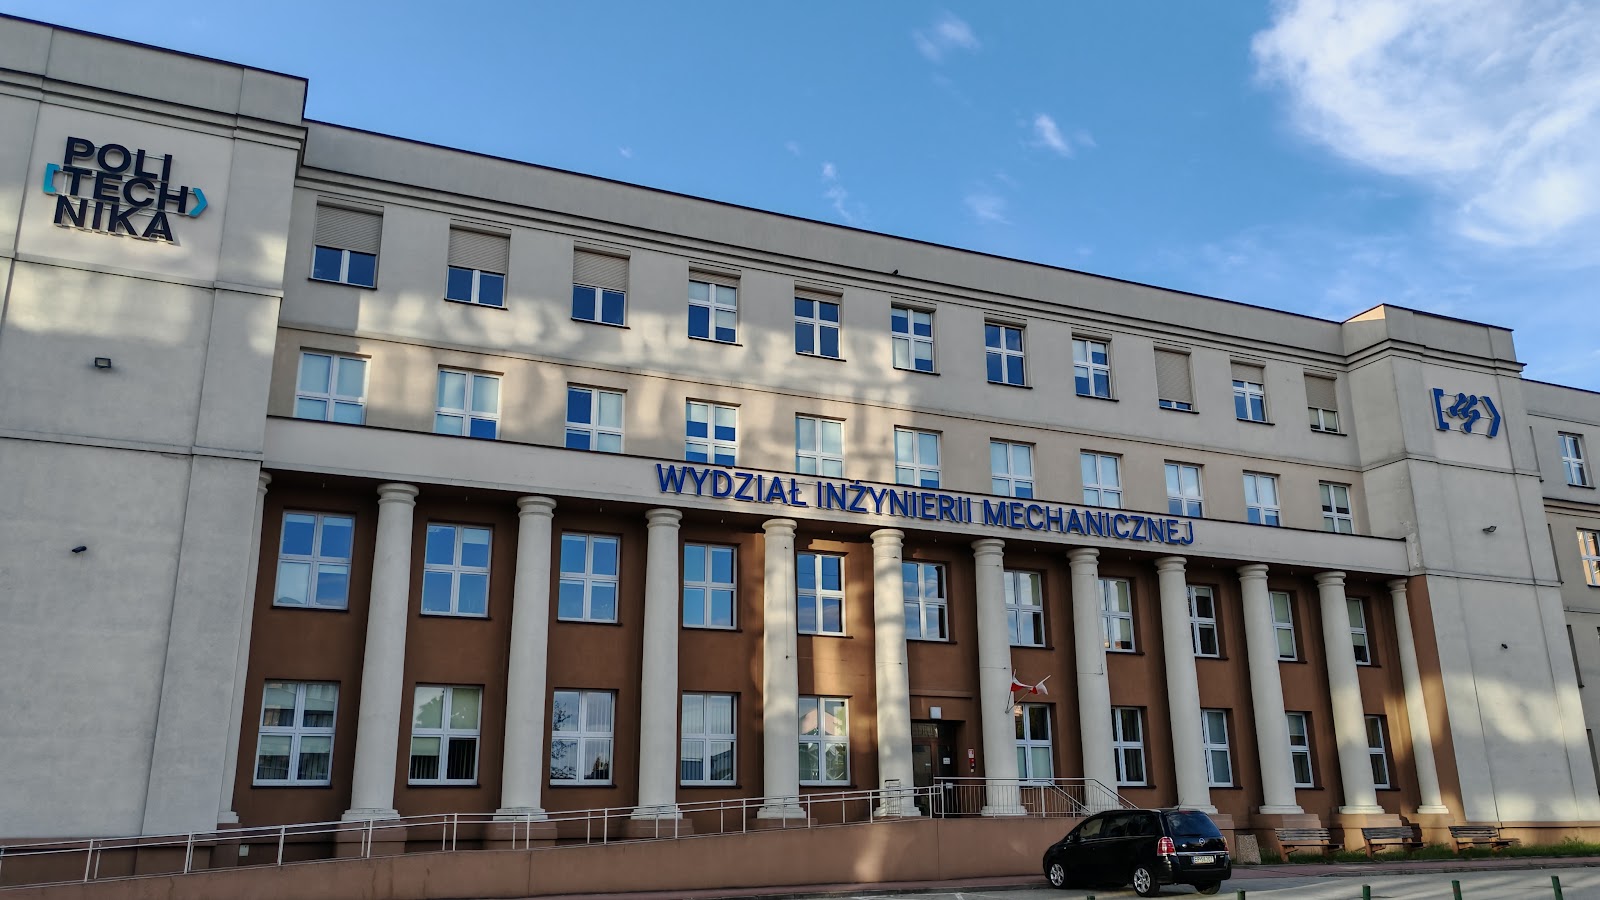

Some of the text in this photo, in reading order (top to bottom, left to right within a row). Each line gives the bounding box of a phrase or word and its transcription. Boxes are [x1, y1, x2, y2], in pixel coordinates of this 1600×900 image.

[64, 136, 173, 184] POLI
[62, 166, 189, 214] TECH
[54, 195, 174, 241] NIKA
[656, 463, 1194, 545] WYDZIAŁ INŻYNIERII MECHANICZNEJ
